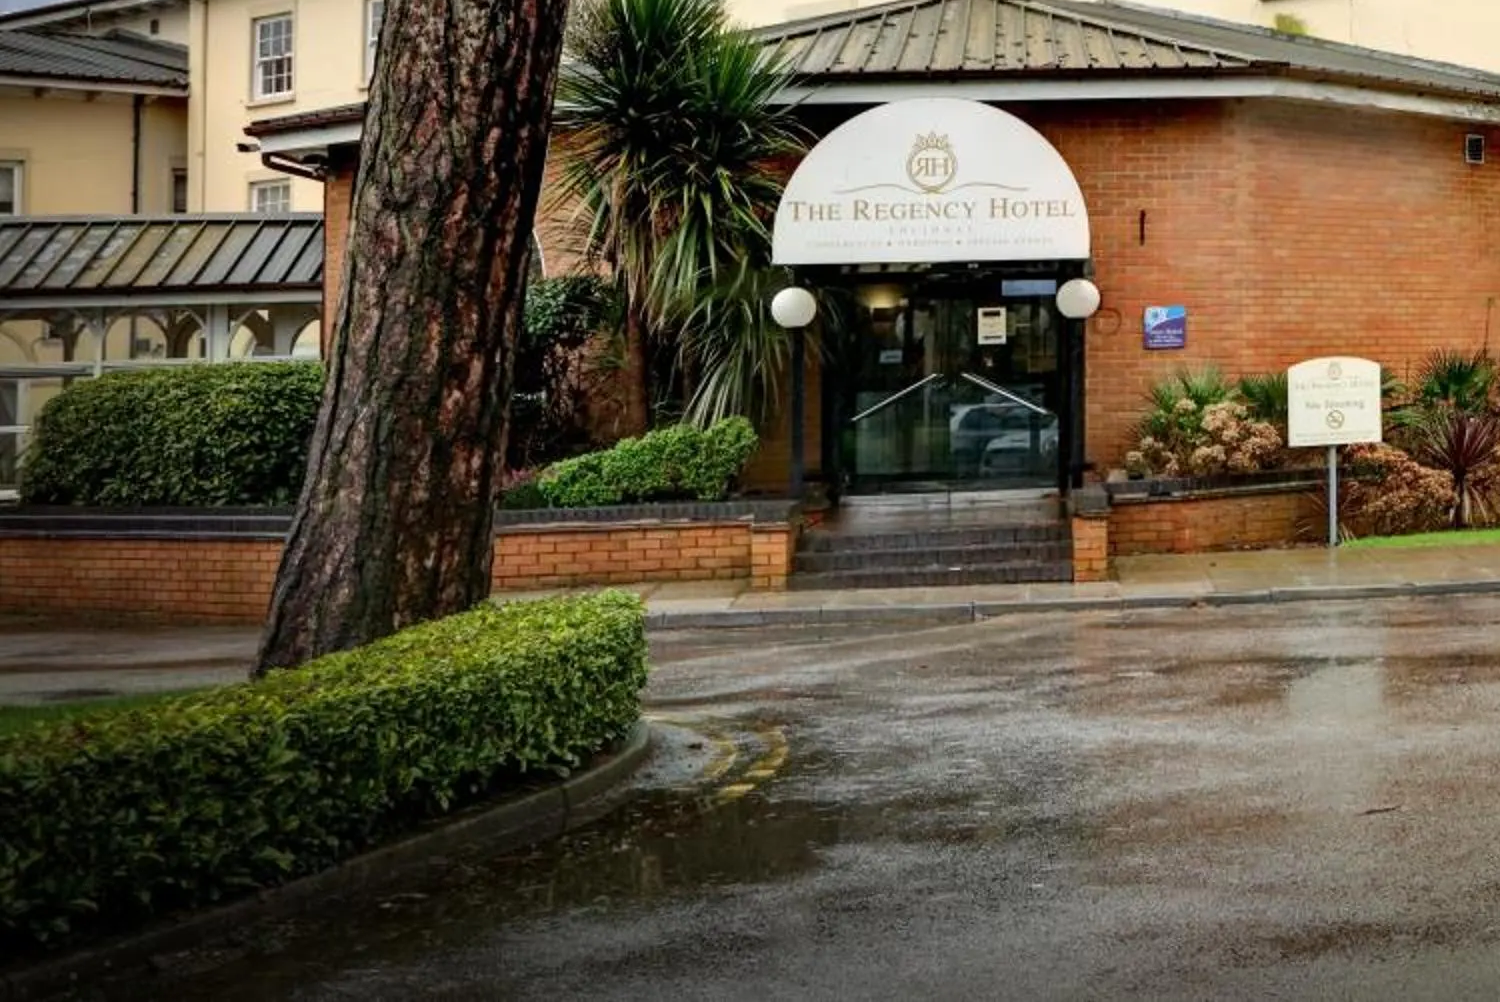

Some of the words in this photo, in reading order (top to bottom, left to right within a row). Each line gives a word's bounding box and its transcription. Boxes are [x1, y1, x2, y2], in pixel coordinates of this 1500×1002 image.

[787, 200, 842, 223] THE
[853, 198, 977, 221] REGENCY
[989, 197, 1076, 219] HOTEL
